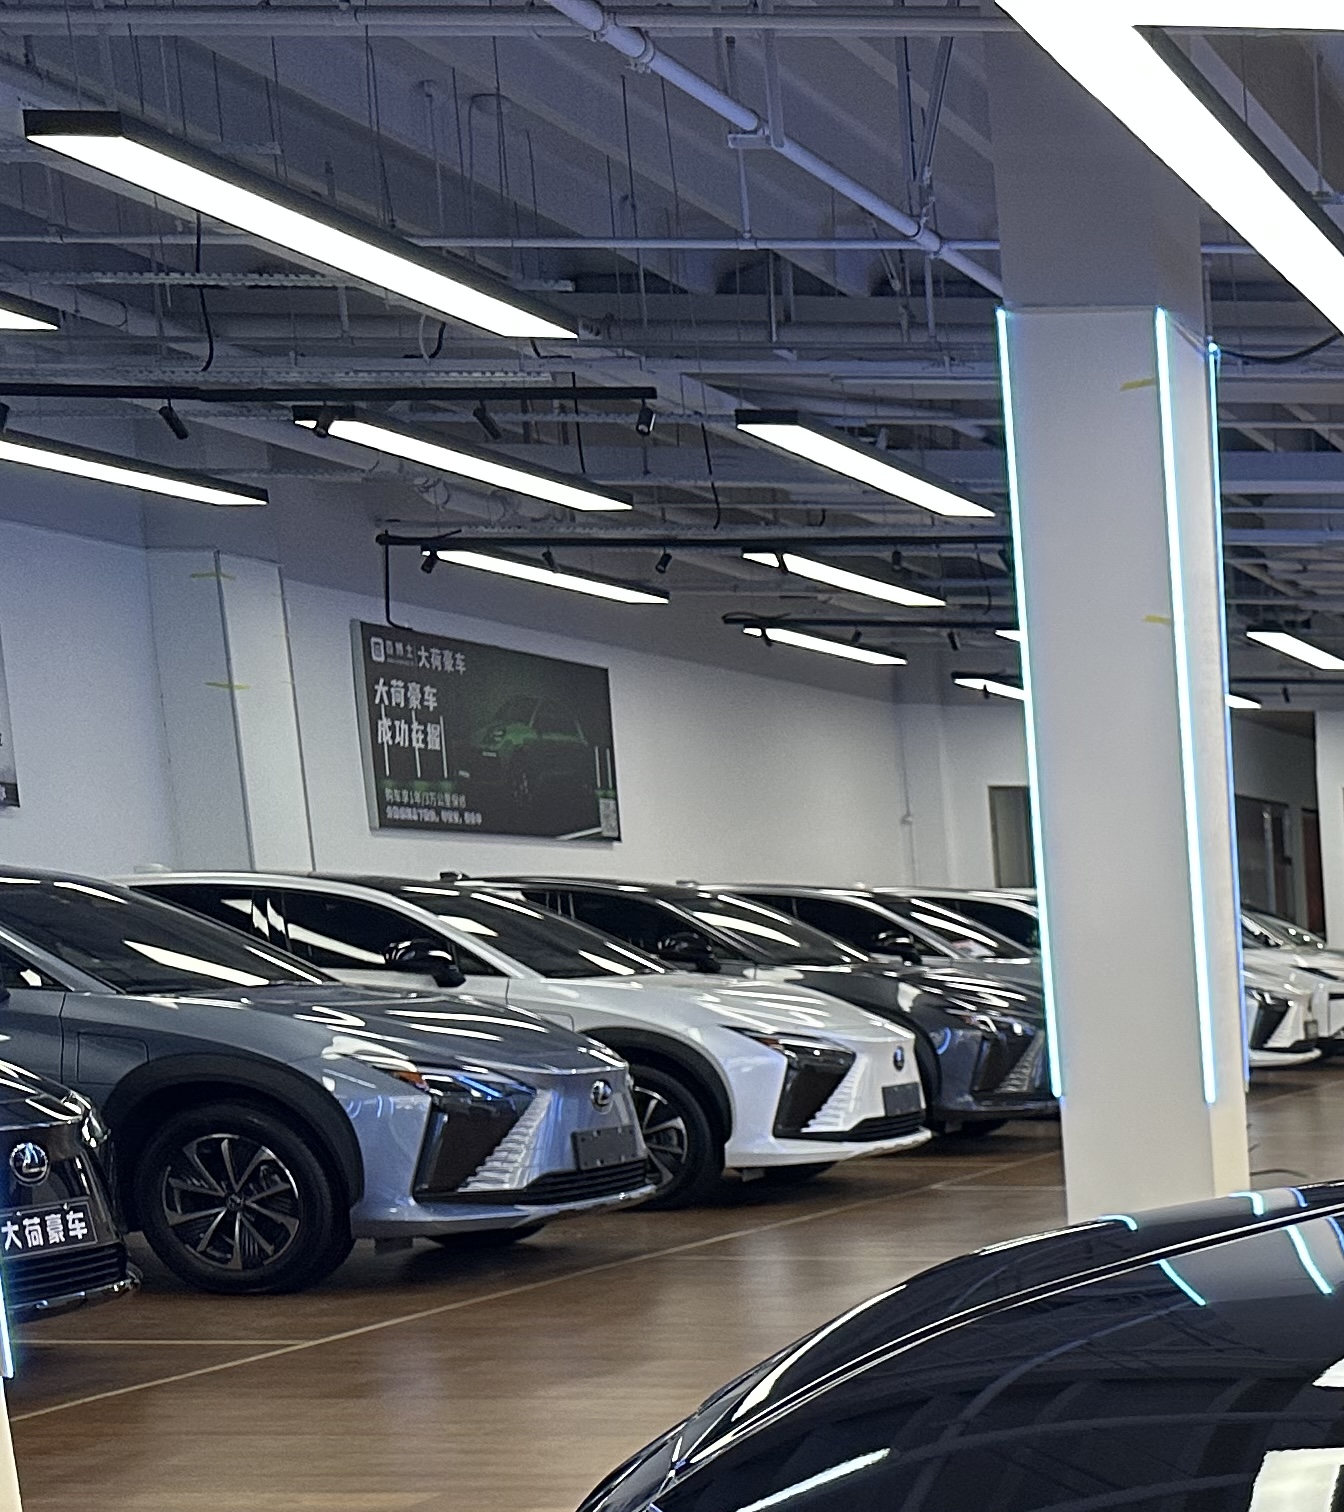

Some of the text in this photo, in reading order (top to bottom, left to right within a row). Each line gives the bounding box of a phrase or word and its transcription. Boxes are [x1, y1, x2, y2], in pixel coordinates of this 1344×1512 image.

[375, 677, 437, 711] 大荷豪车
[1, 1211, 88, 1250] 大荷豪车
